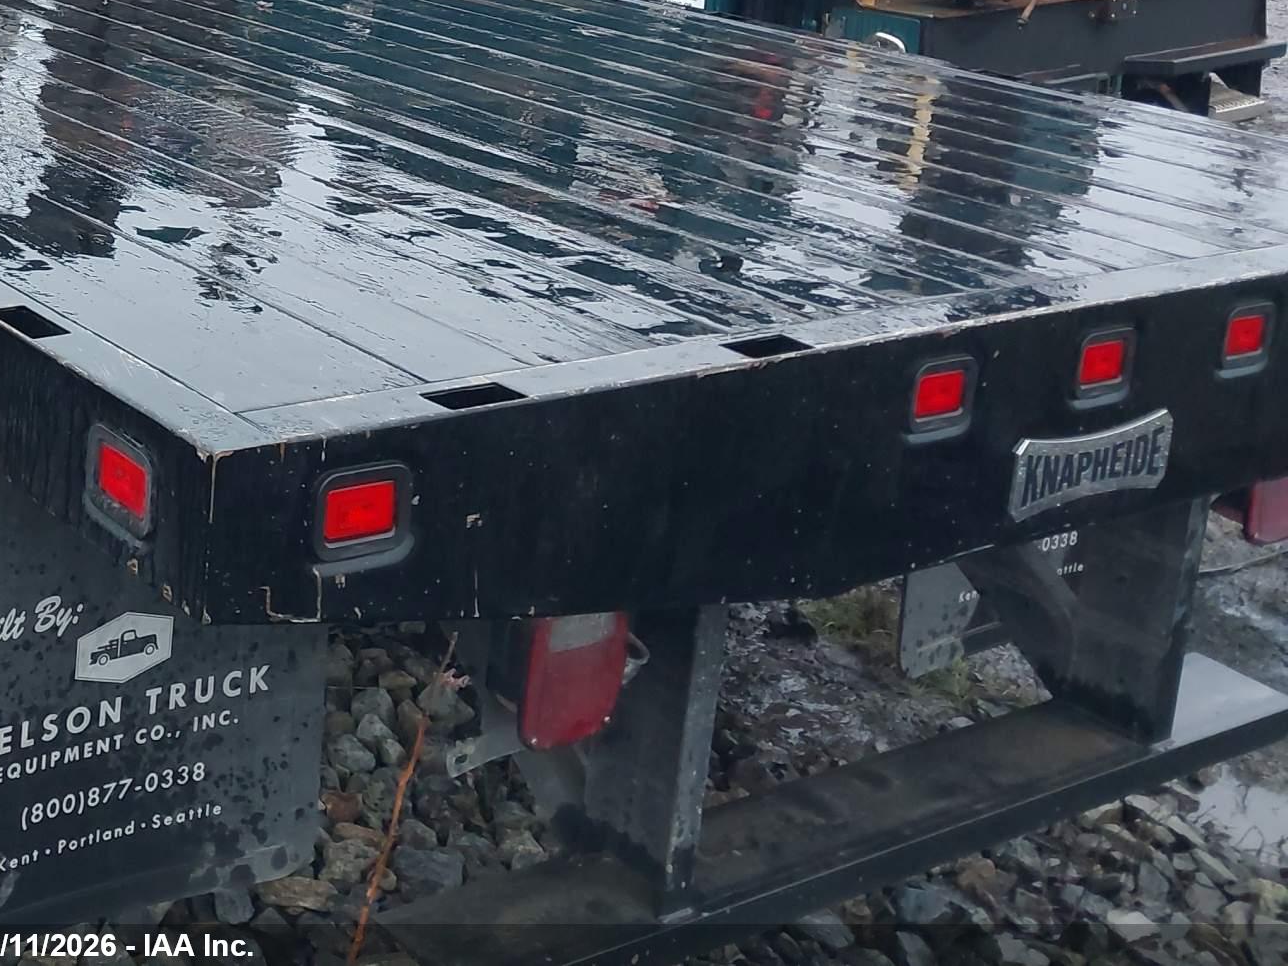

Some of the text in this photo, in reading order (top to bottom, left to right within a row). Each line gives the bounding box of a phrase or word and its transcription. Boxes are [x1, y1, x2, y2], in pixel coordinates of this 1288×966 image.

[1021, 425, 1166, 508] KNAPHEIDE
[1039, 530, 1079, 552] 0338
[1056, 562, 1084, 576] attle
[33, 595, 85, 637] By:
[958, 589, 978, 603] Ken
[145, 664, 270, 715] TRUCK
[134, 724, 181, 745] CO.,
[192, 709, 240, 732] INC.
[20, 761, 206, 831] (800)877-0338
[57, 820, 135, 854] Portland
[152, 802, 223, 829] Seattle
